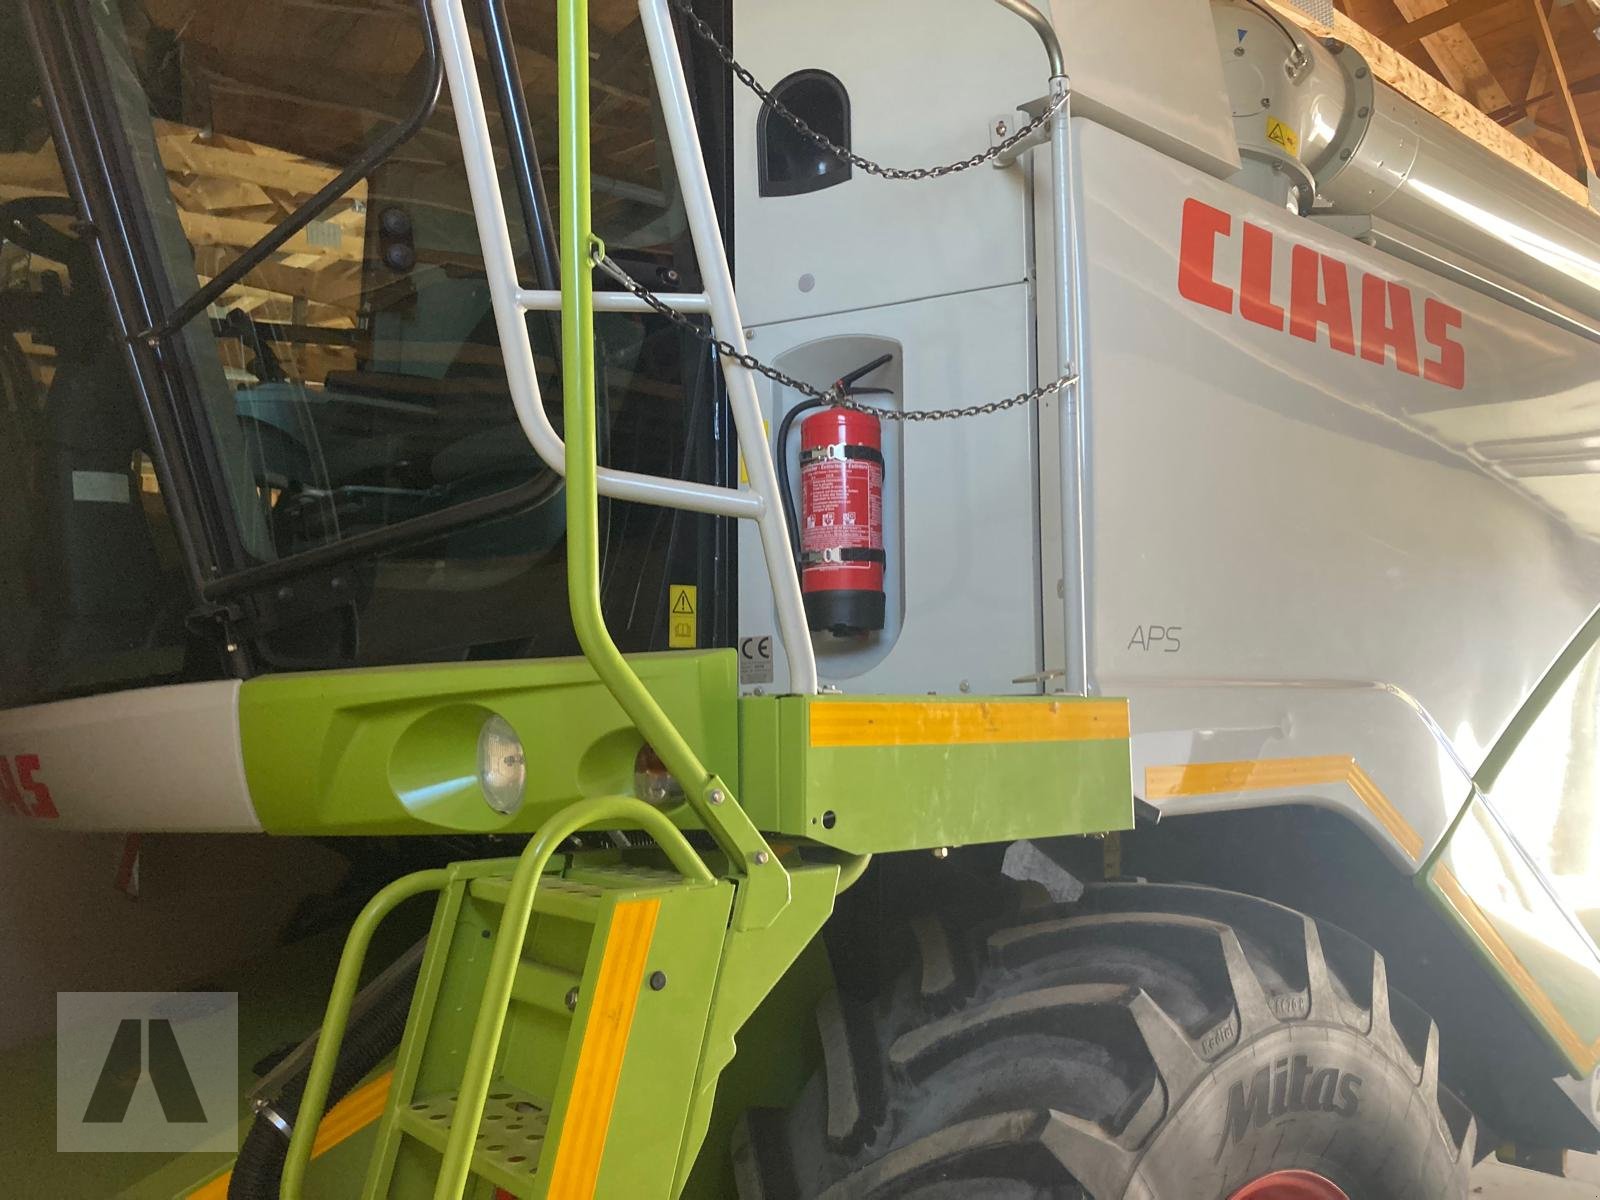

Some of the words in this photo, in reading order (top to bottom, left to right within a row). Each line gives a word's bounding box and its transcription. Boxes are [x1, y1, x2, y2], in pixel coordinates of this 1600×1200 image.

[1178, 197, 1465, 390] CLAAS
[742, 636, 770, 659] CE
[1127, 624, 1182, 652] APS
[1216, 1055, 1363, 1164] Mitas
